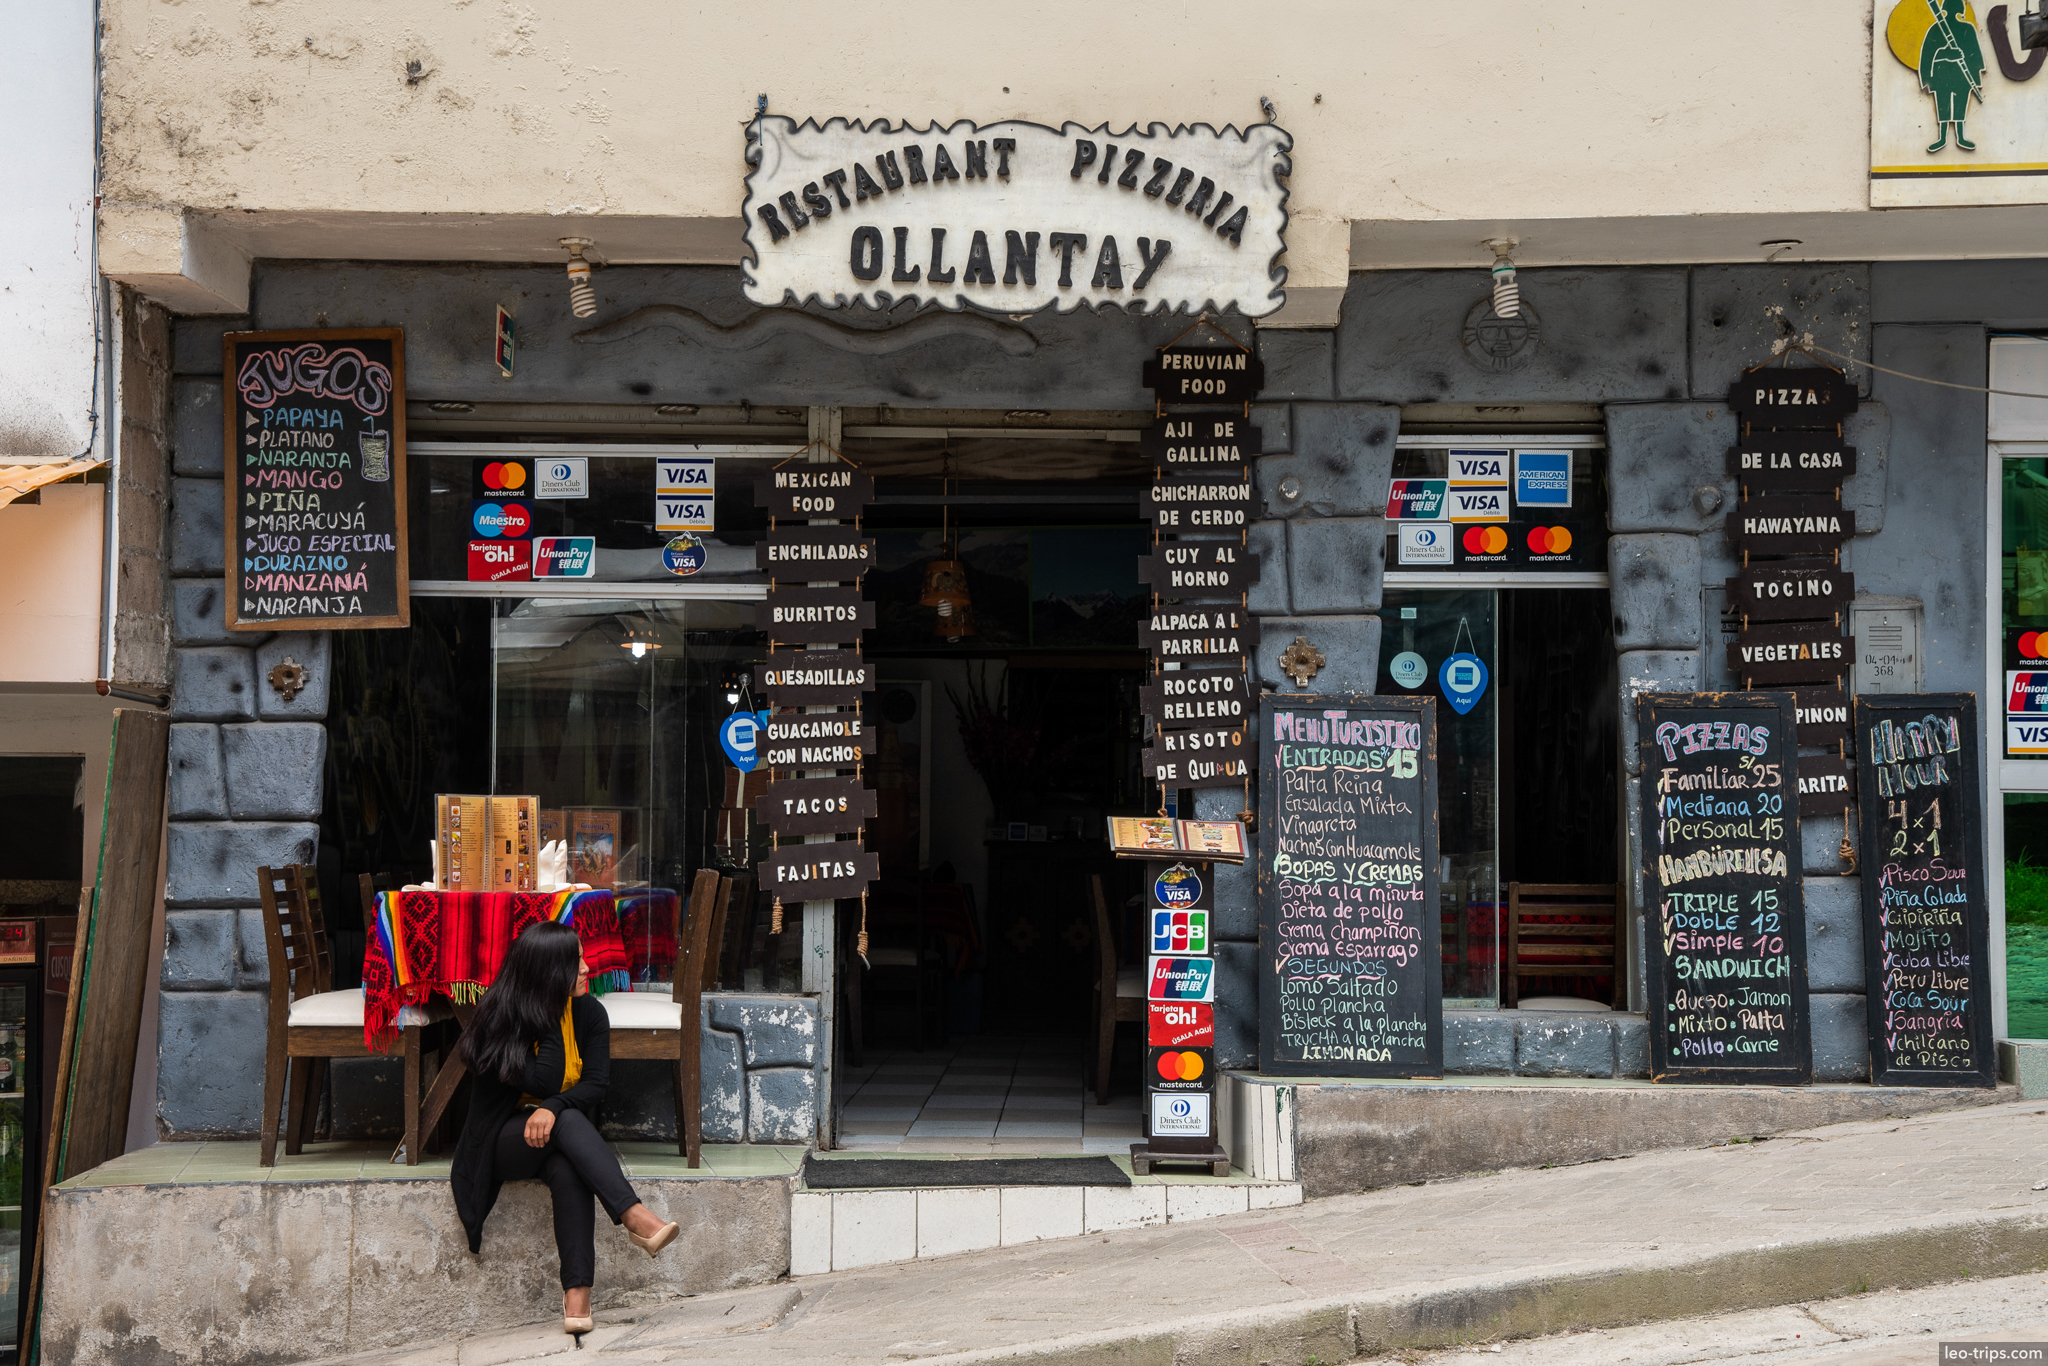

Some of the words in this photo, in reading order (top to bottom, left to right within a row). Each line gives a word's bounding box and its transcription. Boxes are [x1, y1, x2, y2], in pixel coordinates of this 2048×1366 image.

[757, 138, 1016, 243] RESTAURANT
[1071, 139, 1249, 245] PIZZERIA
[849, 225, 1172, 290] OLLANTAY
[1162, 354, 1246, 370] PERUVIAN
[239, 344, 392, 415] JUGOS
[1181, 379, 1226, 394] FOOD
[1756, 389, 1818, 405] PIZZA
[263, 408, 343, 430] PAPAYA
[259, 430, 334, 448] PLATANO
[1165, 422, 1193, 438] AJI
[1214, 422, 1234, 437] DE
[258, 450, 351, 469] NARANJA
[1166, 446, 1240, 462] GALLINA
[1742, 453, 1762, 469] DE
[1770, 453, 1792, 469] LA
[1800, 452, 1842, 469] CASA
[663, 469, 707, 483] VISA
[1456, 460, 1501, 475] VISA
[1519, 471, 1565, 479] AMERICAN
[256, 469, 342, 489] MANGO
[776, 472, 851, 488] MEXICAN
[1528, 481, 1567, 489] EXPRESS
[259, 490, 320, 512] PIÑA
[1152, 485, 1249, 501] CHICHARRON
[1392, 490, 1442, 503] UnionPay
[663, 504, 705, 519] VISA
[793, 496, 835, 511] FOOD
[1456, 496, 1499, 510] VISA
[258, 502, 365, 532] MARACUYÁ
[479, 515, 524, 526] Maestro
[1159, 510, 1179, 525] DE
[1191, 510, 1244, 525] CERDO
[1744, 517, 1840, 534] HAWAYANA
[256, 534, 301, 553] JUGO
[308, 534, 395, 552] ESPECIAL
[470, 544, 497, 552] Tarjeta
[769, 545, 868, 560] ENCHILADAS
[485, 546, 514, 562] oh!
[540, 548, 589, 560] UnionPay
[671, 558, 696, 567] VISA
[1166, 549, 1199, 564] CUY
[1216, 548, 1235, 563] AL
[254, 555, 348, 572] DURAZNO
[1172, 571, 1229, 587] HORNO
[1753, 580, 1832, 598] TOCINO
[256, 596, 362, 615] NARANJA
[774, 606, 856, 622] BURRITOS
[1151, 614, 1208, 631] ALPACA
[1215, 613, 1238, 628] AL
[1162, 638, 1239, 654] PARRILLA
[1742, 642, 1842, 662] VEGETALES
[765, 669, 865, 685] QUESADILLAS
[1874, 666, 1894, 676] 368
[1164, 677, 1234, 695] ROCOTO
[1165, 700, 1241, 719] RELLENO
[768, 721, 861, 740] GUACAMOLE
[1165, 732, 1242, 751] RISOTO
[1656, 721, 1770, 762] PIZZAS
[768, 748, 796, 764] CON
[802, 746, 861, 763] NACHOS
[1283, 745, 1383, 768] ENTRADAS
[1387, 748, 1418, 779] 15
[1157, 764, 1177, 780] DE
[1752, 764, 1782, 789] 25
[1283, 770, 1327, 793] Palta
[1332, 770, 1383, 794] Reina
[784, 797, 847, 815] TACOS
[1286, 794, 1355, 814] Ensalada
[1360, 794, 1412, 816] Mixta
[1666, 793, 1751, 819] Mediana
[1757, 793, 1782, 814] 20
[1281, 814, 1357, 841] Vinagreta
[1760, 817, 1784, 841] 15
[777, 862, 856, 882] FAJITAS
[1165, 891, 1191, 900] VISA
[1279, 879, 1322, 901] Sopa
[1369, 883, 1424, 901] minuta
[1668, 893, 1739, 912] TRIPLE
[1750, 889, 1778, 912] 15
[1281, 901, 1327, 919] Dieta
[1333, 901, 1353, 919] de
[1358, 902, 1403, 922] pollo
[1155, 925, 1204, 939] JCB
[1750, 913, 1780, 934] 12
[1752, 935, 1783, 957] 10
[1156, 968, 1208, 983] UnionPay
[1288, 958, 1387, 976] SEGUNDOS
[1675, 955, 1790, 979] SANDWICH
[1737, 987, 1791, 1006] Jamon
[1150, 1005, 1178, 1013] Tarjeta
[1165, 1007, 1197, 1025] oh!
[1737, 1009, 1785, 1031] Palta
[1172, 1032, 1193, 1044] ÚSALA
[1194, 1025, 1212, 1036] AQUÍ
[1282, 1031, 1339, 1047] TRUCHA
[1302, 1046, 1391, 1062] LIMONADA
